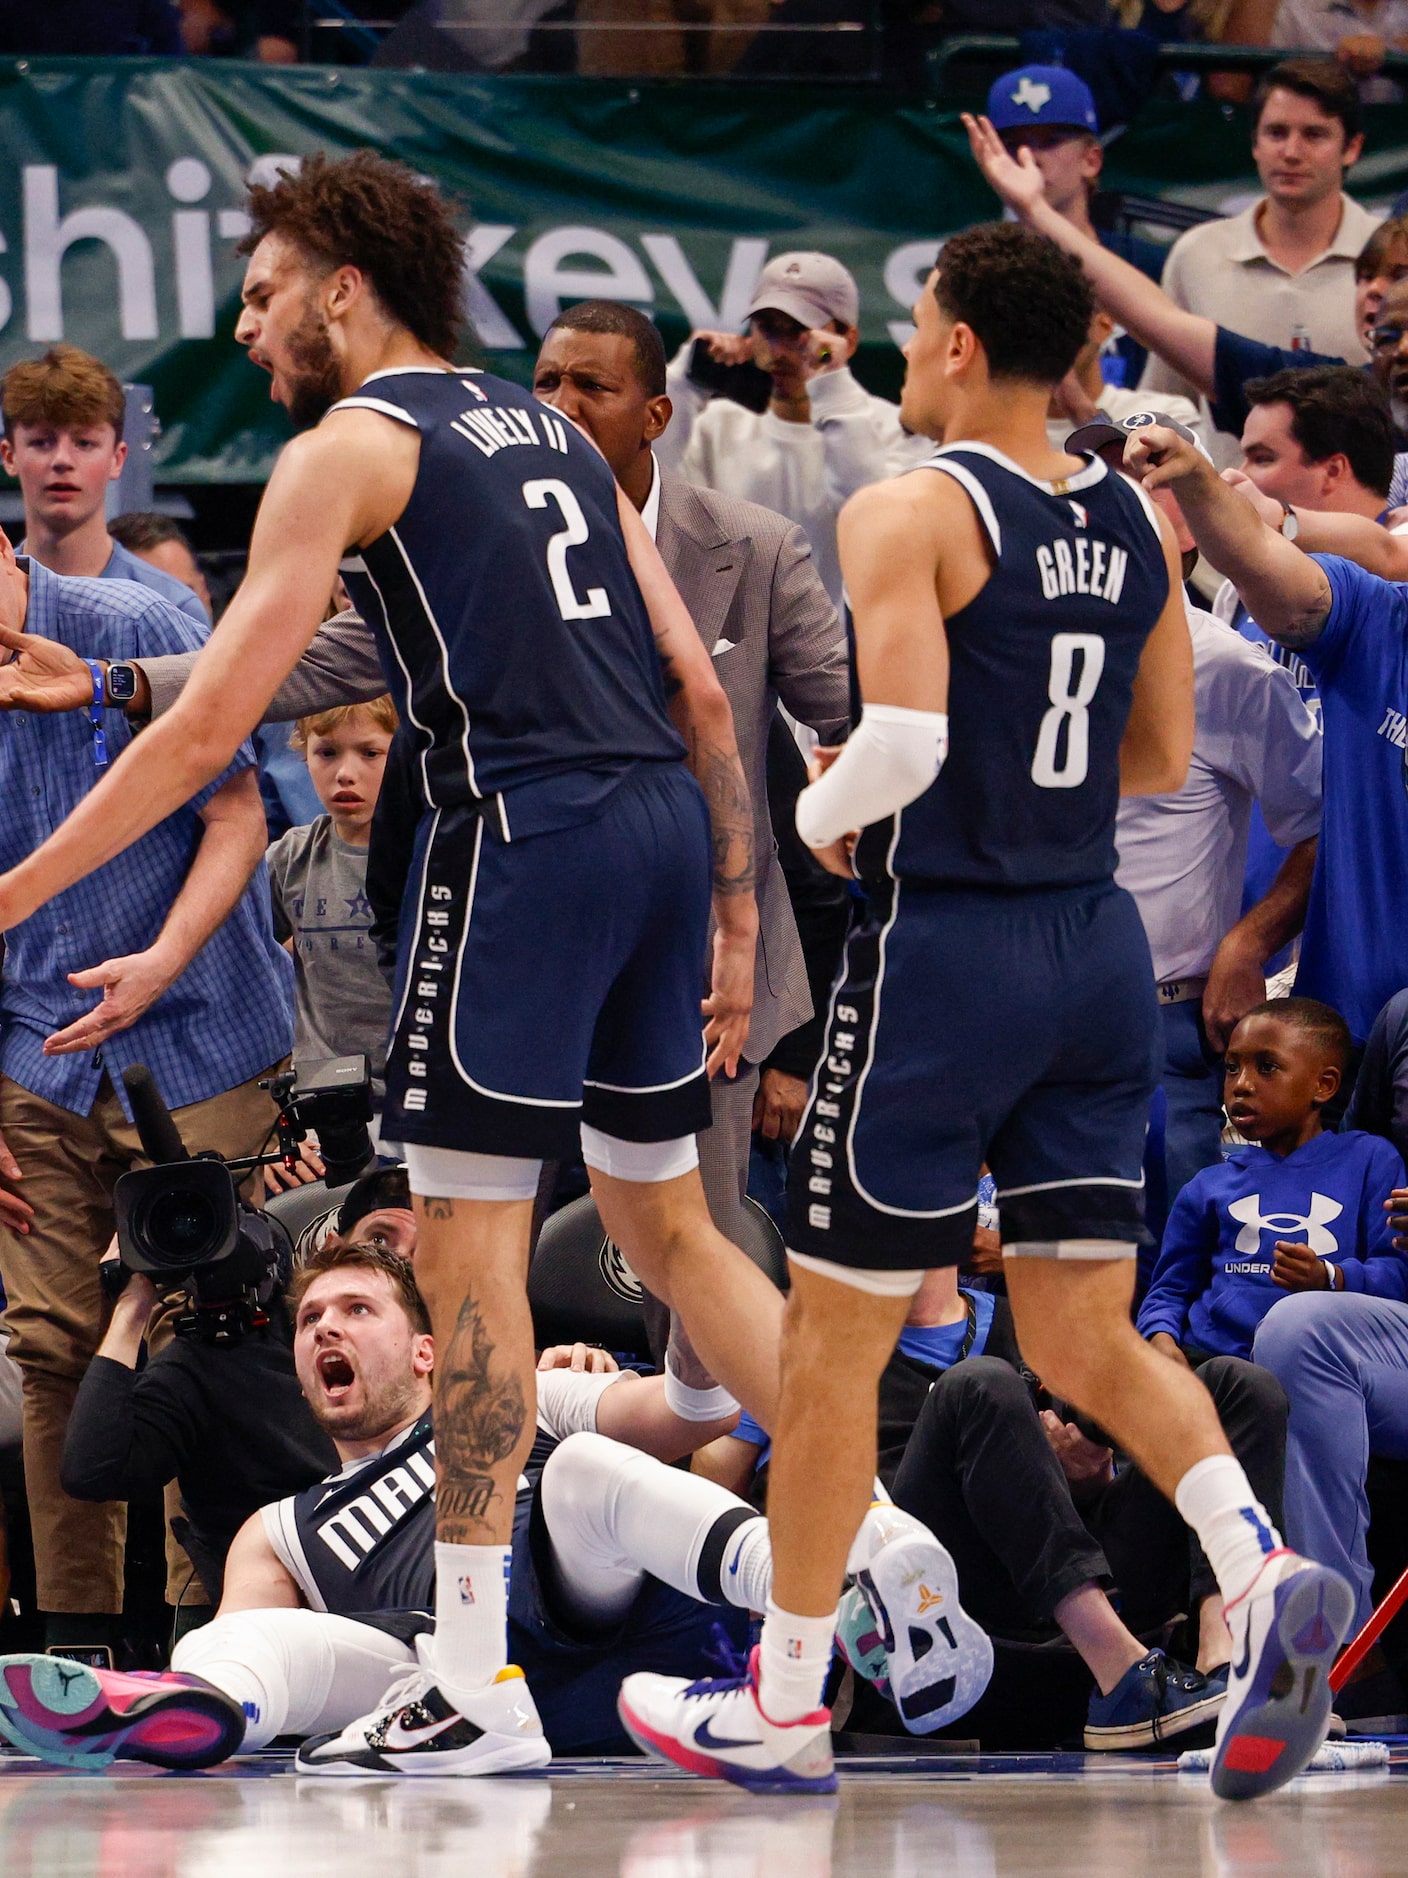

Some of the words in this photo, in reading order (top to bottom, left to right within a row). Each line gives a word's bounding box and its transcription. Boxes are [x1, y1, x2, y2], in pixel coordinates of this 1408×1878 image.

[450, 407, 540, 458] LIVELY
[540, 412, 568, 455] II
[522, 478, 612, 621] 2
[1036, 537, 1128, 605] GREEN
[1031, 632, 1105, 788] 8
[1225, 1263, 1270, 1274] UNDER
